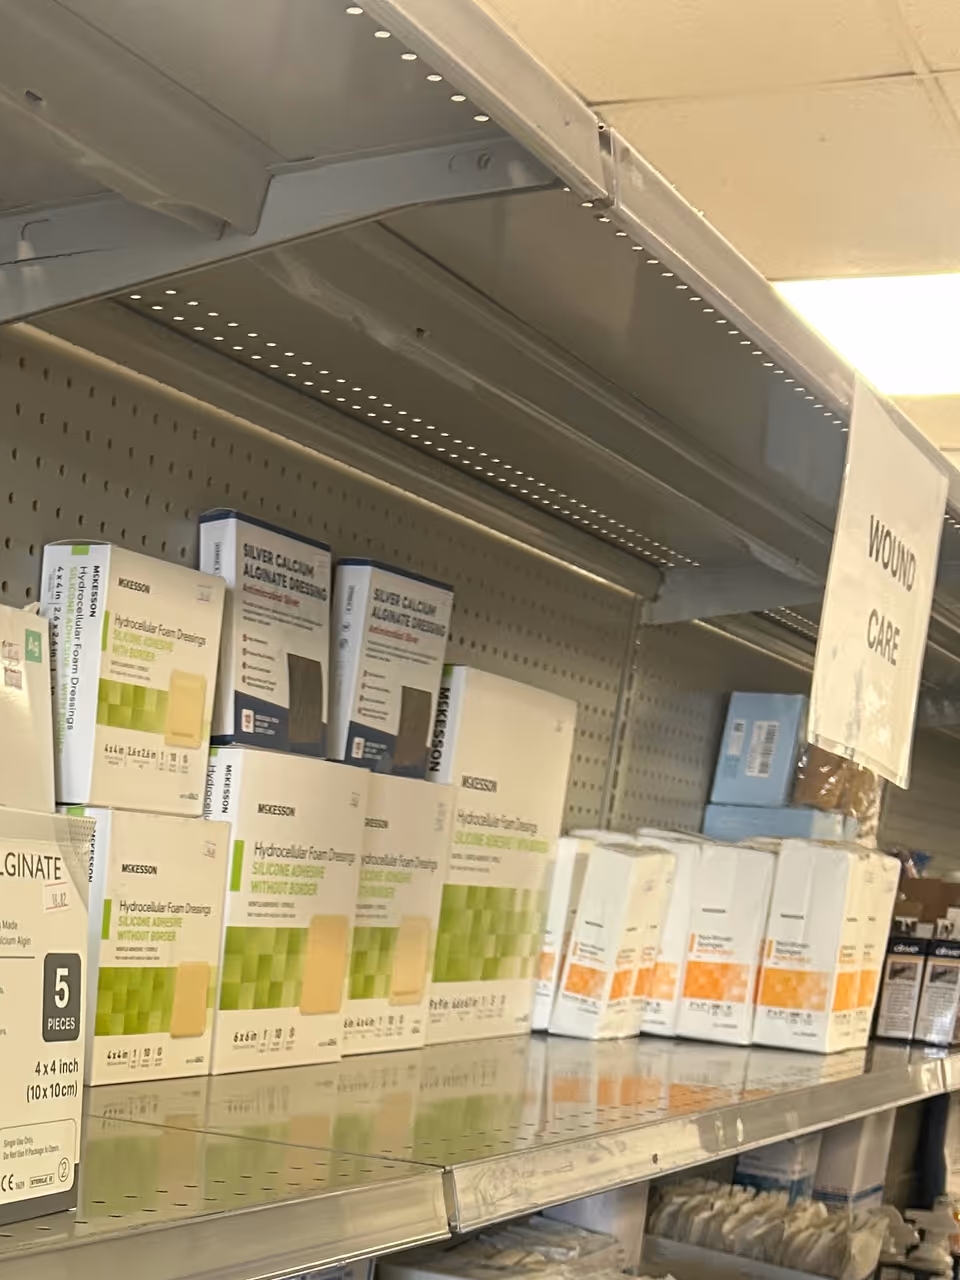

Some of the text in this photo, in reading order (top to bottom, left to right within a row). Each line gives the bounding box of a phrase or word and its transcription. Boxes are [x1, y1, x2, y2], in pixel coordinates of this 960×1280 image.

[868, 514, 916, 593] WOUND
[866, 608, 900, 666] CARE
[119, 901, 167, 915] Hydrocellular
[167, 902, 184, 913] Foam
[2, 920, 18, 929] Made
[55, 968, 69, 1009] 5
[48, 1018, 75, 1030] PIECES
[35, 1062, 41, 1075] 4
[50, 1061, 56, 1074] 4
[59, 1059, 78, 1074] inch
